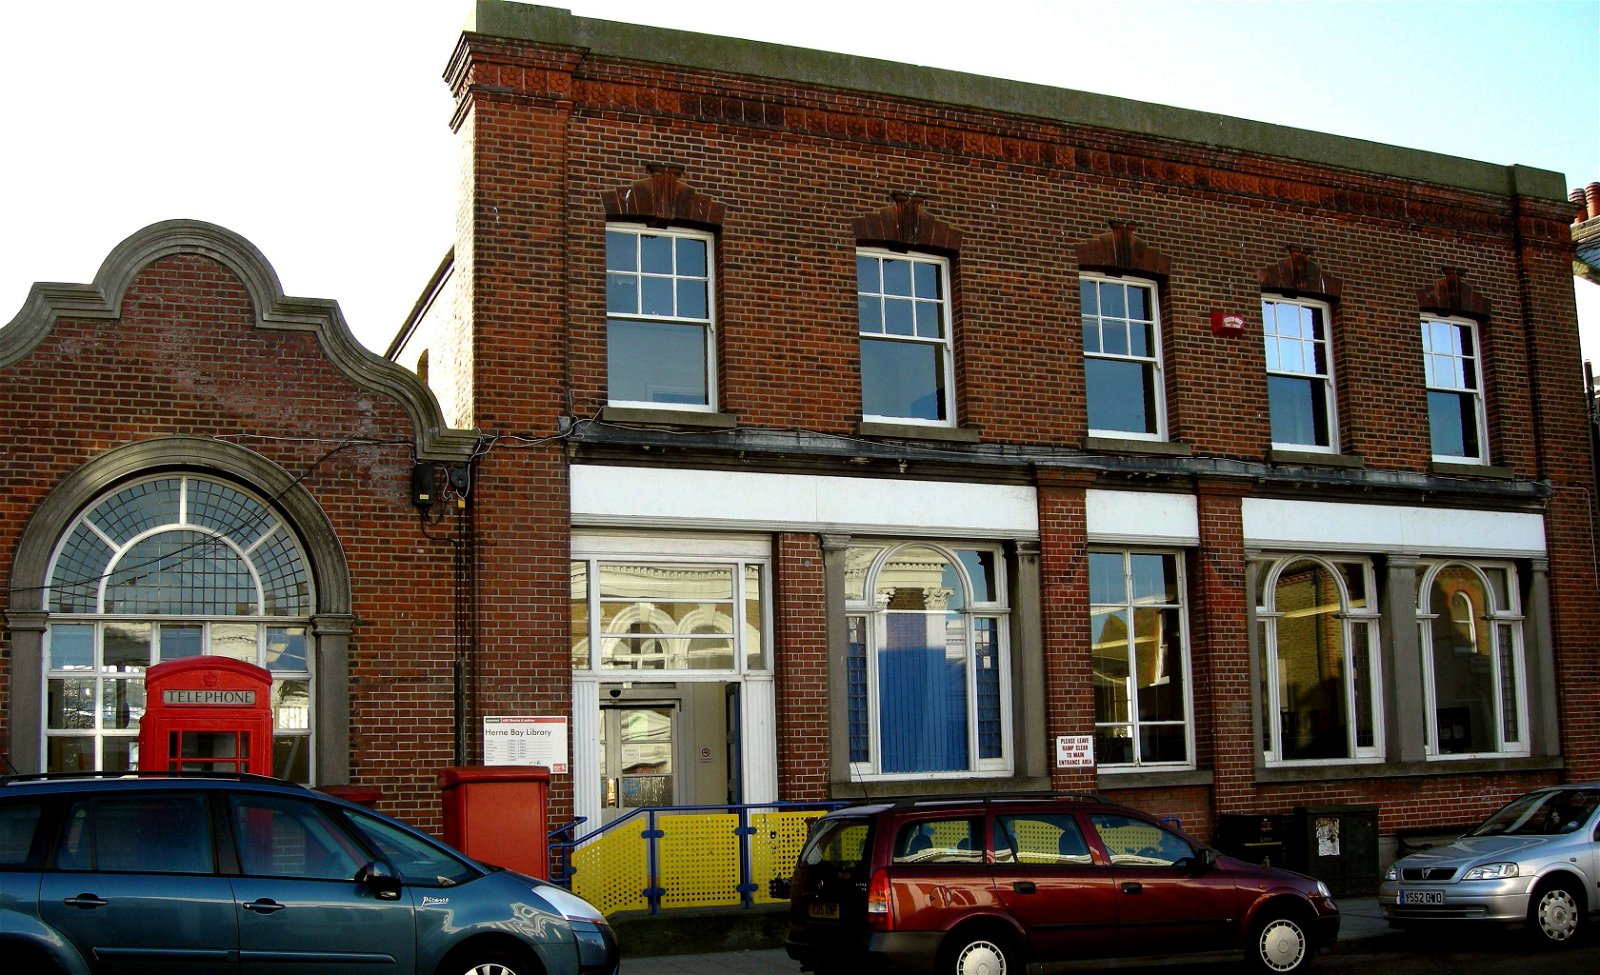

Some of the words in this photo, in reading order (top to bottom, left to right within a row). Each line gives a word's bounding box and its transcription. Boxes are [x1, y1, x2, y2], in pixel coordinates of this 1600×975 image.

[167, 690, 253, 703] TELEPHONE
[510, 728, 524, 737] Bay
[526, 728, 552, 737] Library
